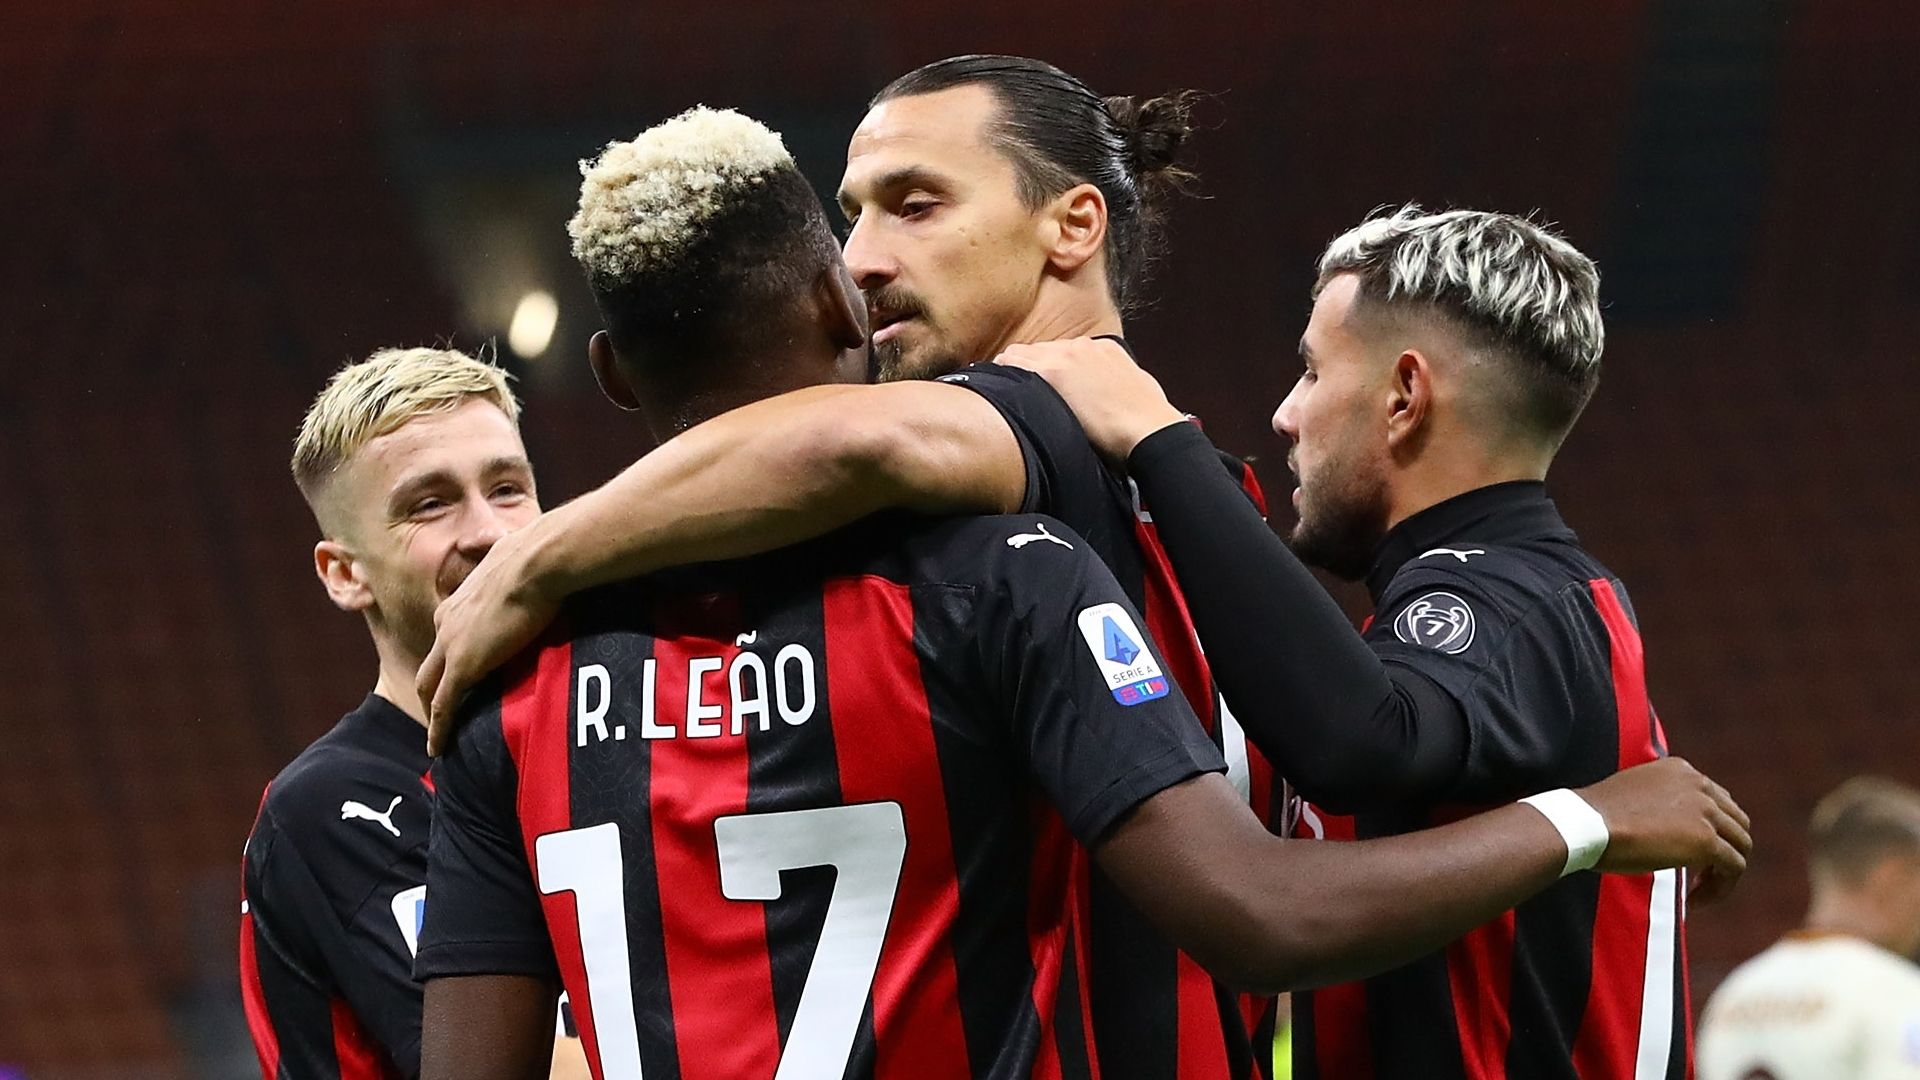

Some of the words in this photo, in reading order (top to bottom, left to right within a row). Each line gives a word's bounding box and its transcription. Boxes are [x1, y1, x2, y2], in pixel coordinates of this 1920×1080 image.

[1427, 620, 1445, 636] 7
[1113, 666, 1145, 683] SERIE
[1147, 665, 1154, 674] A
[536, 802, 907, 1080] 17
